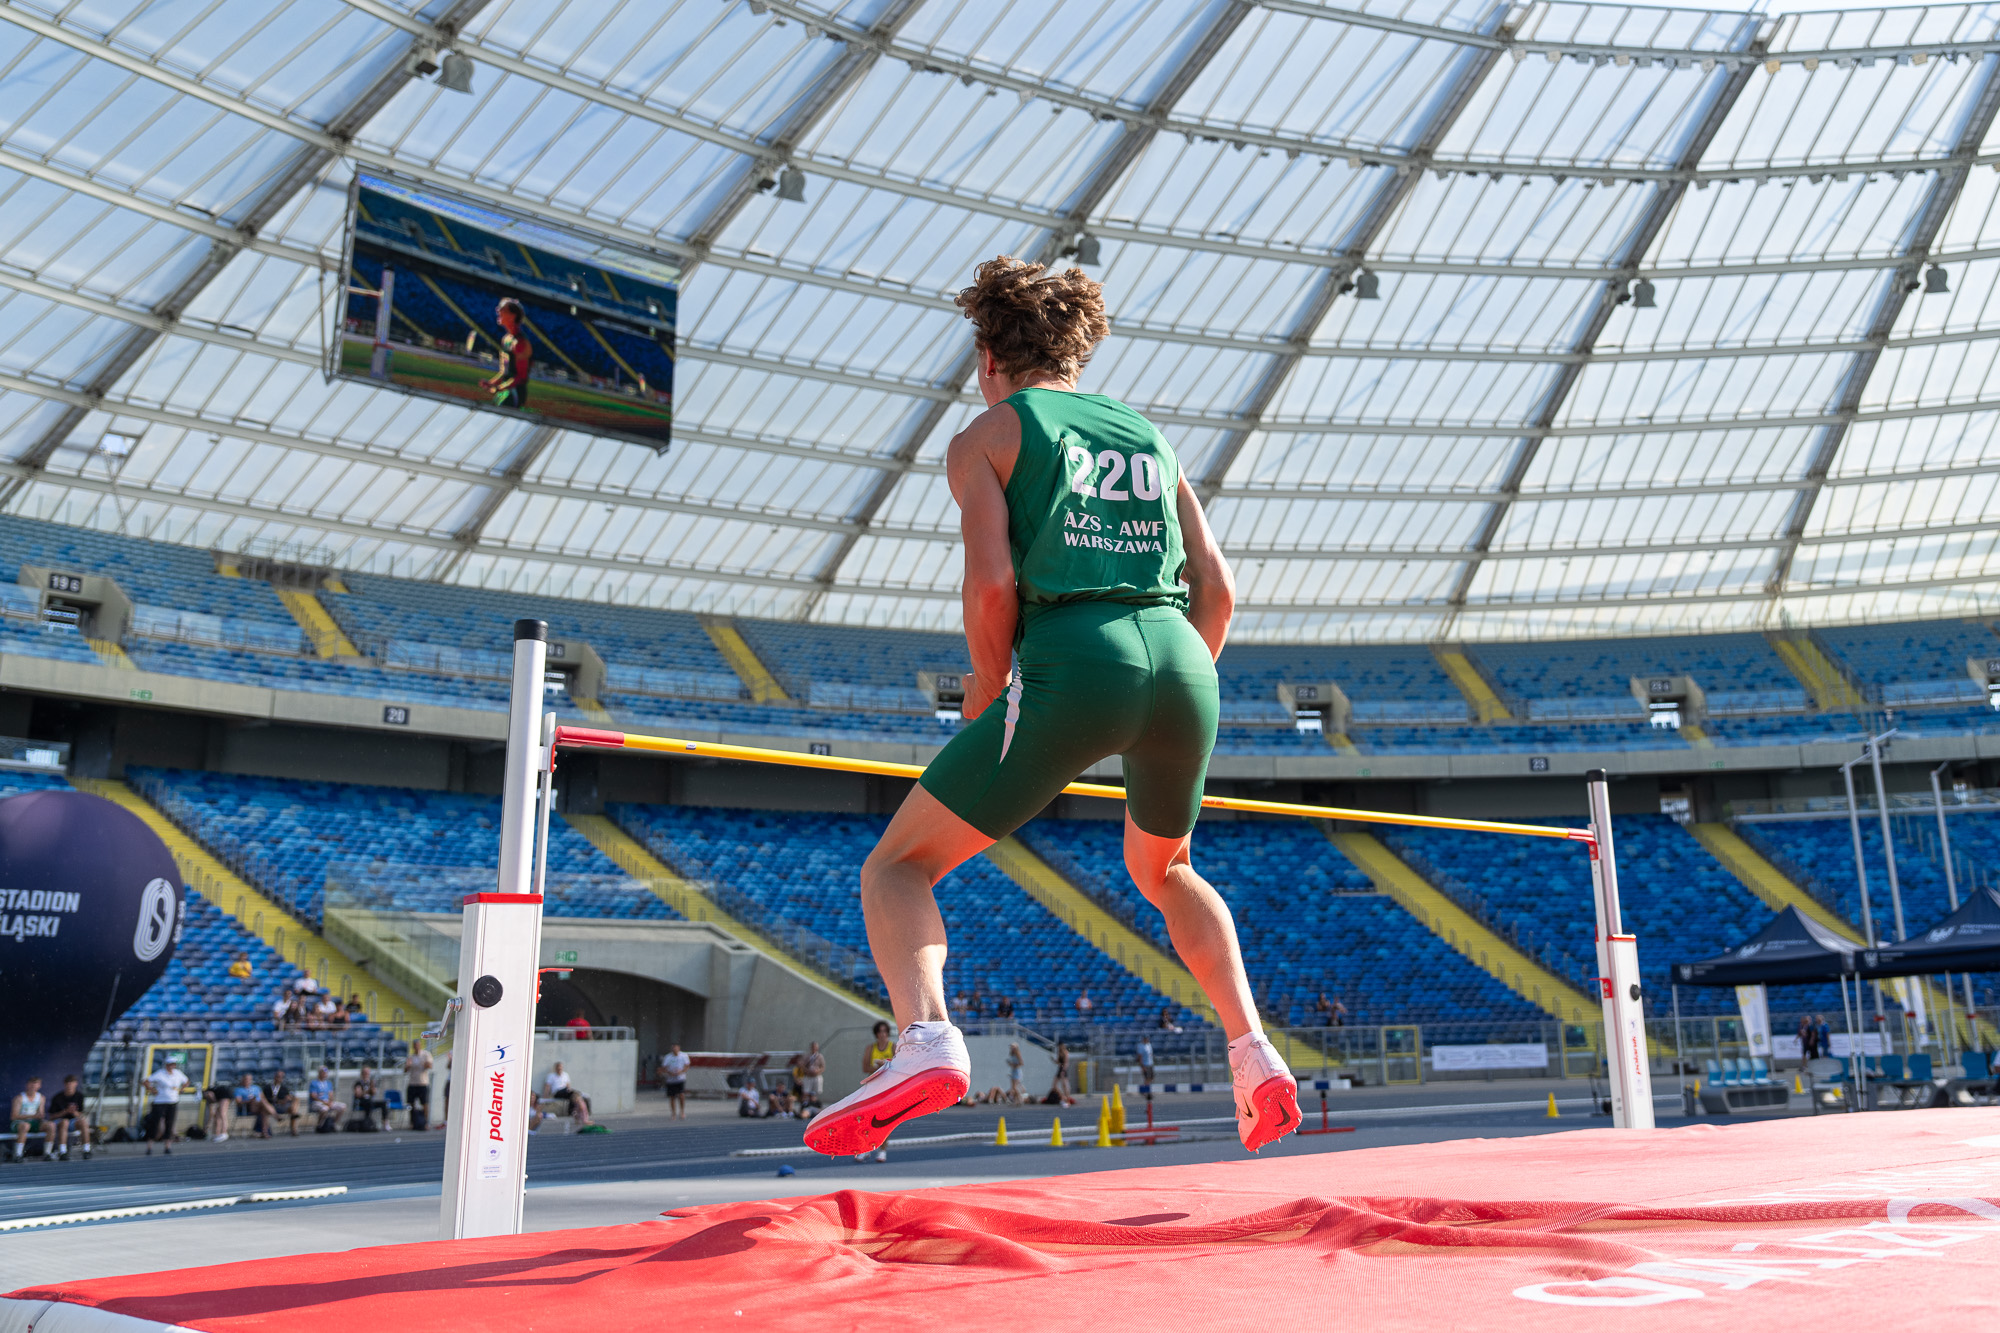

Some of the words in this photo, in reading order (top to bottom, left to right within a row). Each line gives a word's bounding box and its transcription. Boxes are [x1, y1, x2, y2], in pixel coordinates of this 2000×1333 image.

[1068, 446, 1161, 501] 220
[1064, 511, 1102, 532] AZS
[1119, 520, 1164, 537] AWF
[1064, 531, 1163, 554] WARSZAWA
[387, 708, 405, 723] 20
[0, 888, 81, 913] STADION
[0, 910, 61, 943] LĄSKI
[488, 1071, 505, 1142] polanik
